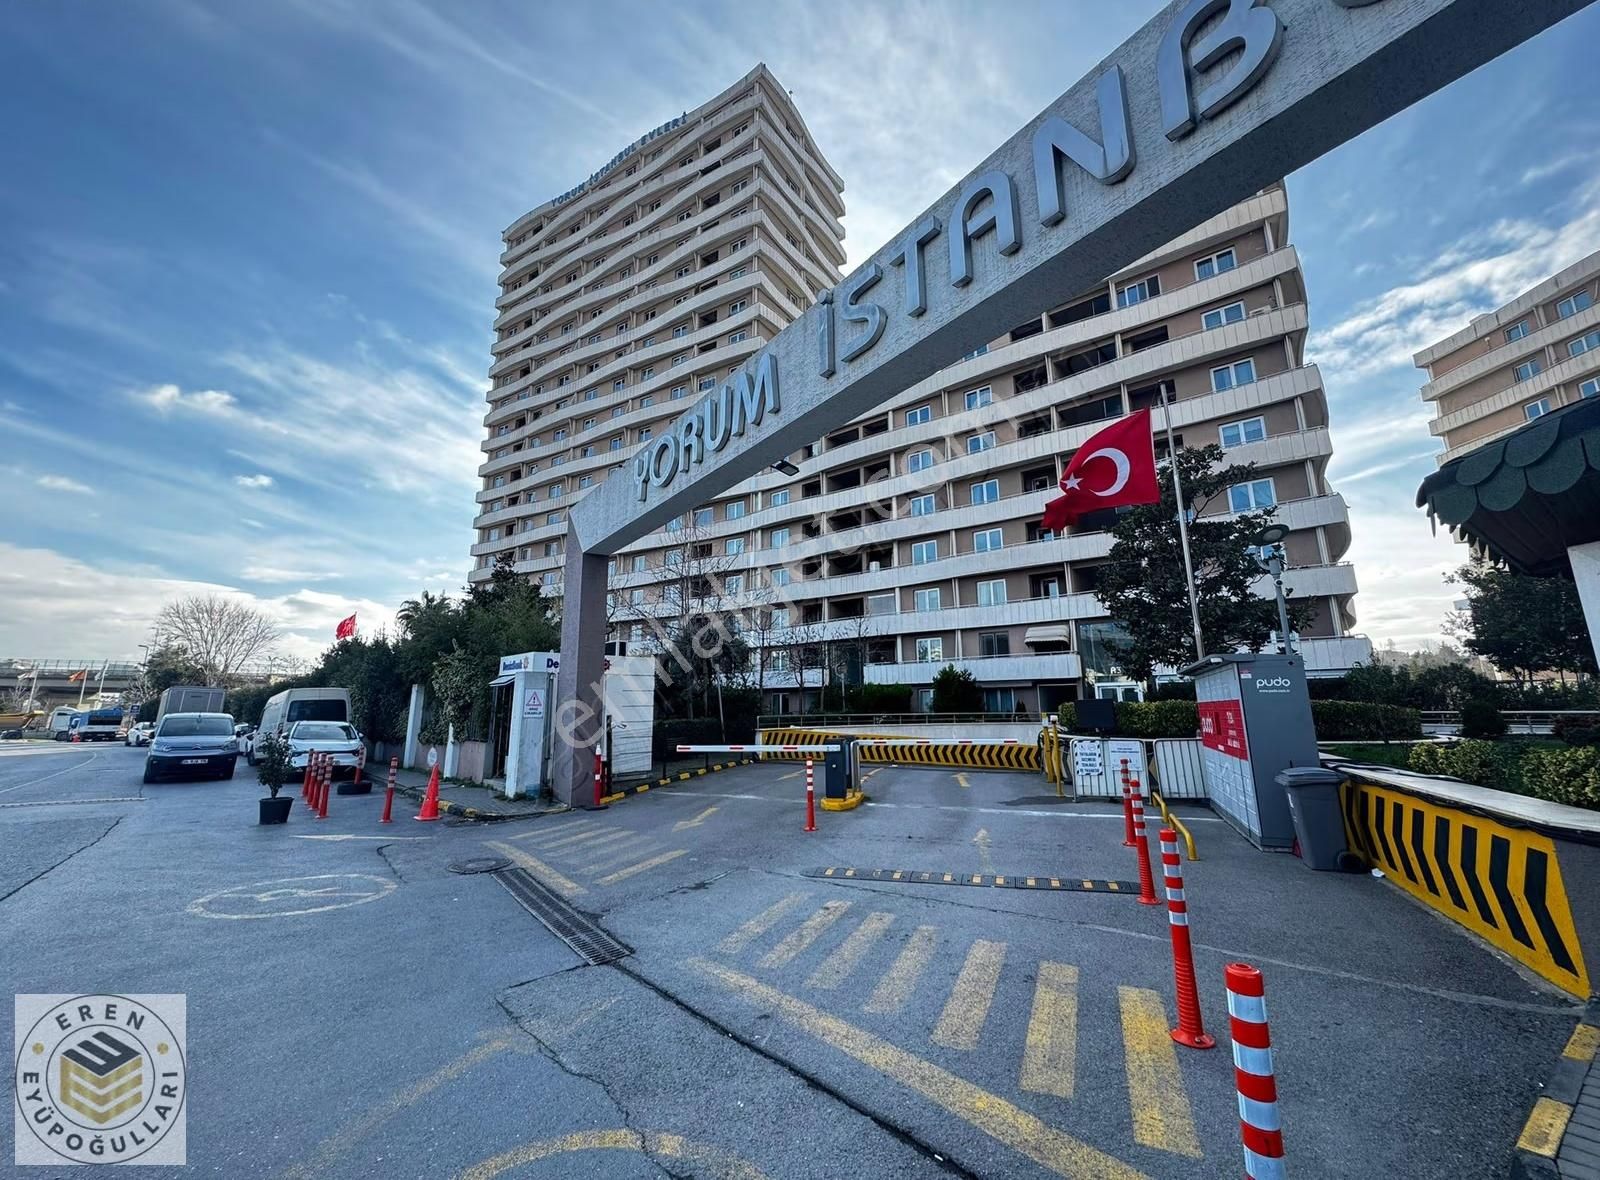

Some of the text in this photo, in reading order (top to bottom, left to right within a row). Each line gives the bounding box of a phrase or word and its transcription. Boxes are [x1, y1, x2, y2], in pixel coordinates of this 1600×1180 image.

[551, 185, 585, 207] YORUM
[633, 0, 1388, 502] YORUM İSTANB
[1256, 677, 1291, 689] pudo
